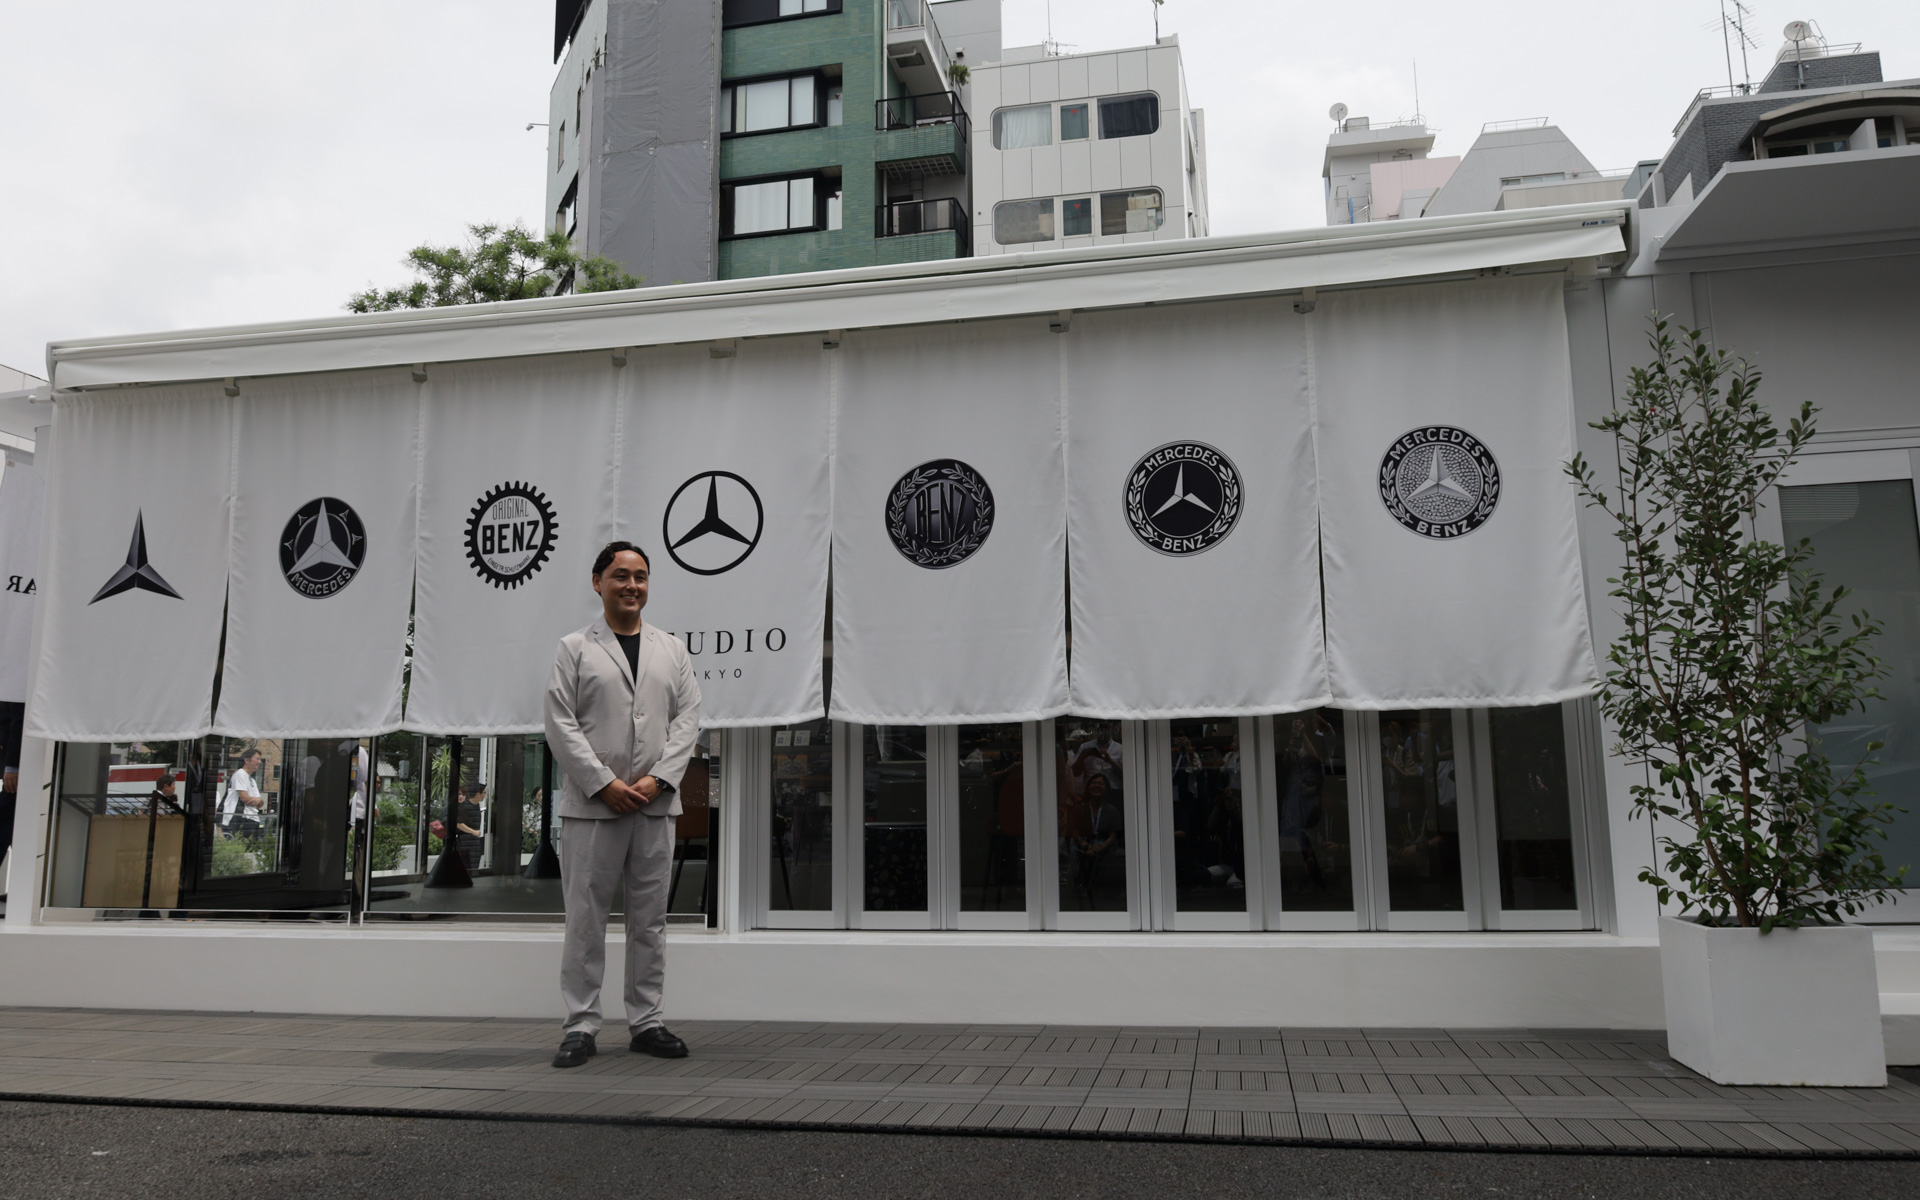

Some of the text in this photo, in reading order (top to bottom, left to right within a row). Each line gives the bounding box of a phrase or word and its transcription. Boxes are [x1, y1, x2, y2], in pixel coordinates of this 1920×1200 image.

[1389, 428, 1484, 460] MERCEDES
[1144, 446, 1220, 471] MERCEDES
[492, 497, 529, 520] ORIGINAL
[914, 480, 967, 545] BENZ
[482, 520, 540, 555] BENZ
[1416, 519, 1472, 537] BENZ
[1161, 534, 1206, 552] BENZ
[291, 568, 352, 595] MERCEDES
[668, 627, 787, 656] UDIO
[692, 668, 742, 680] KYO
